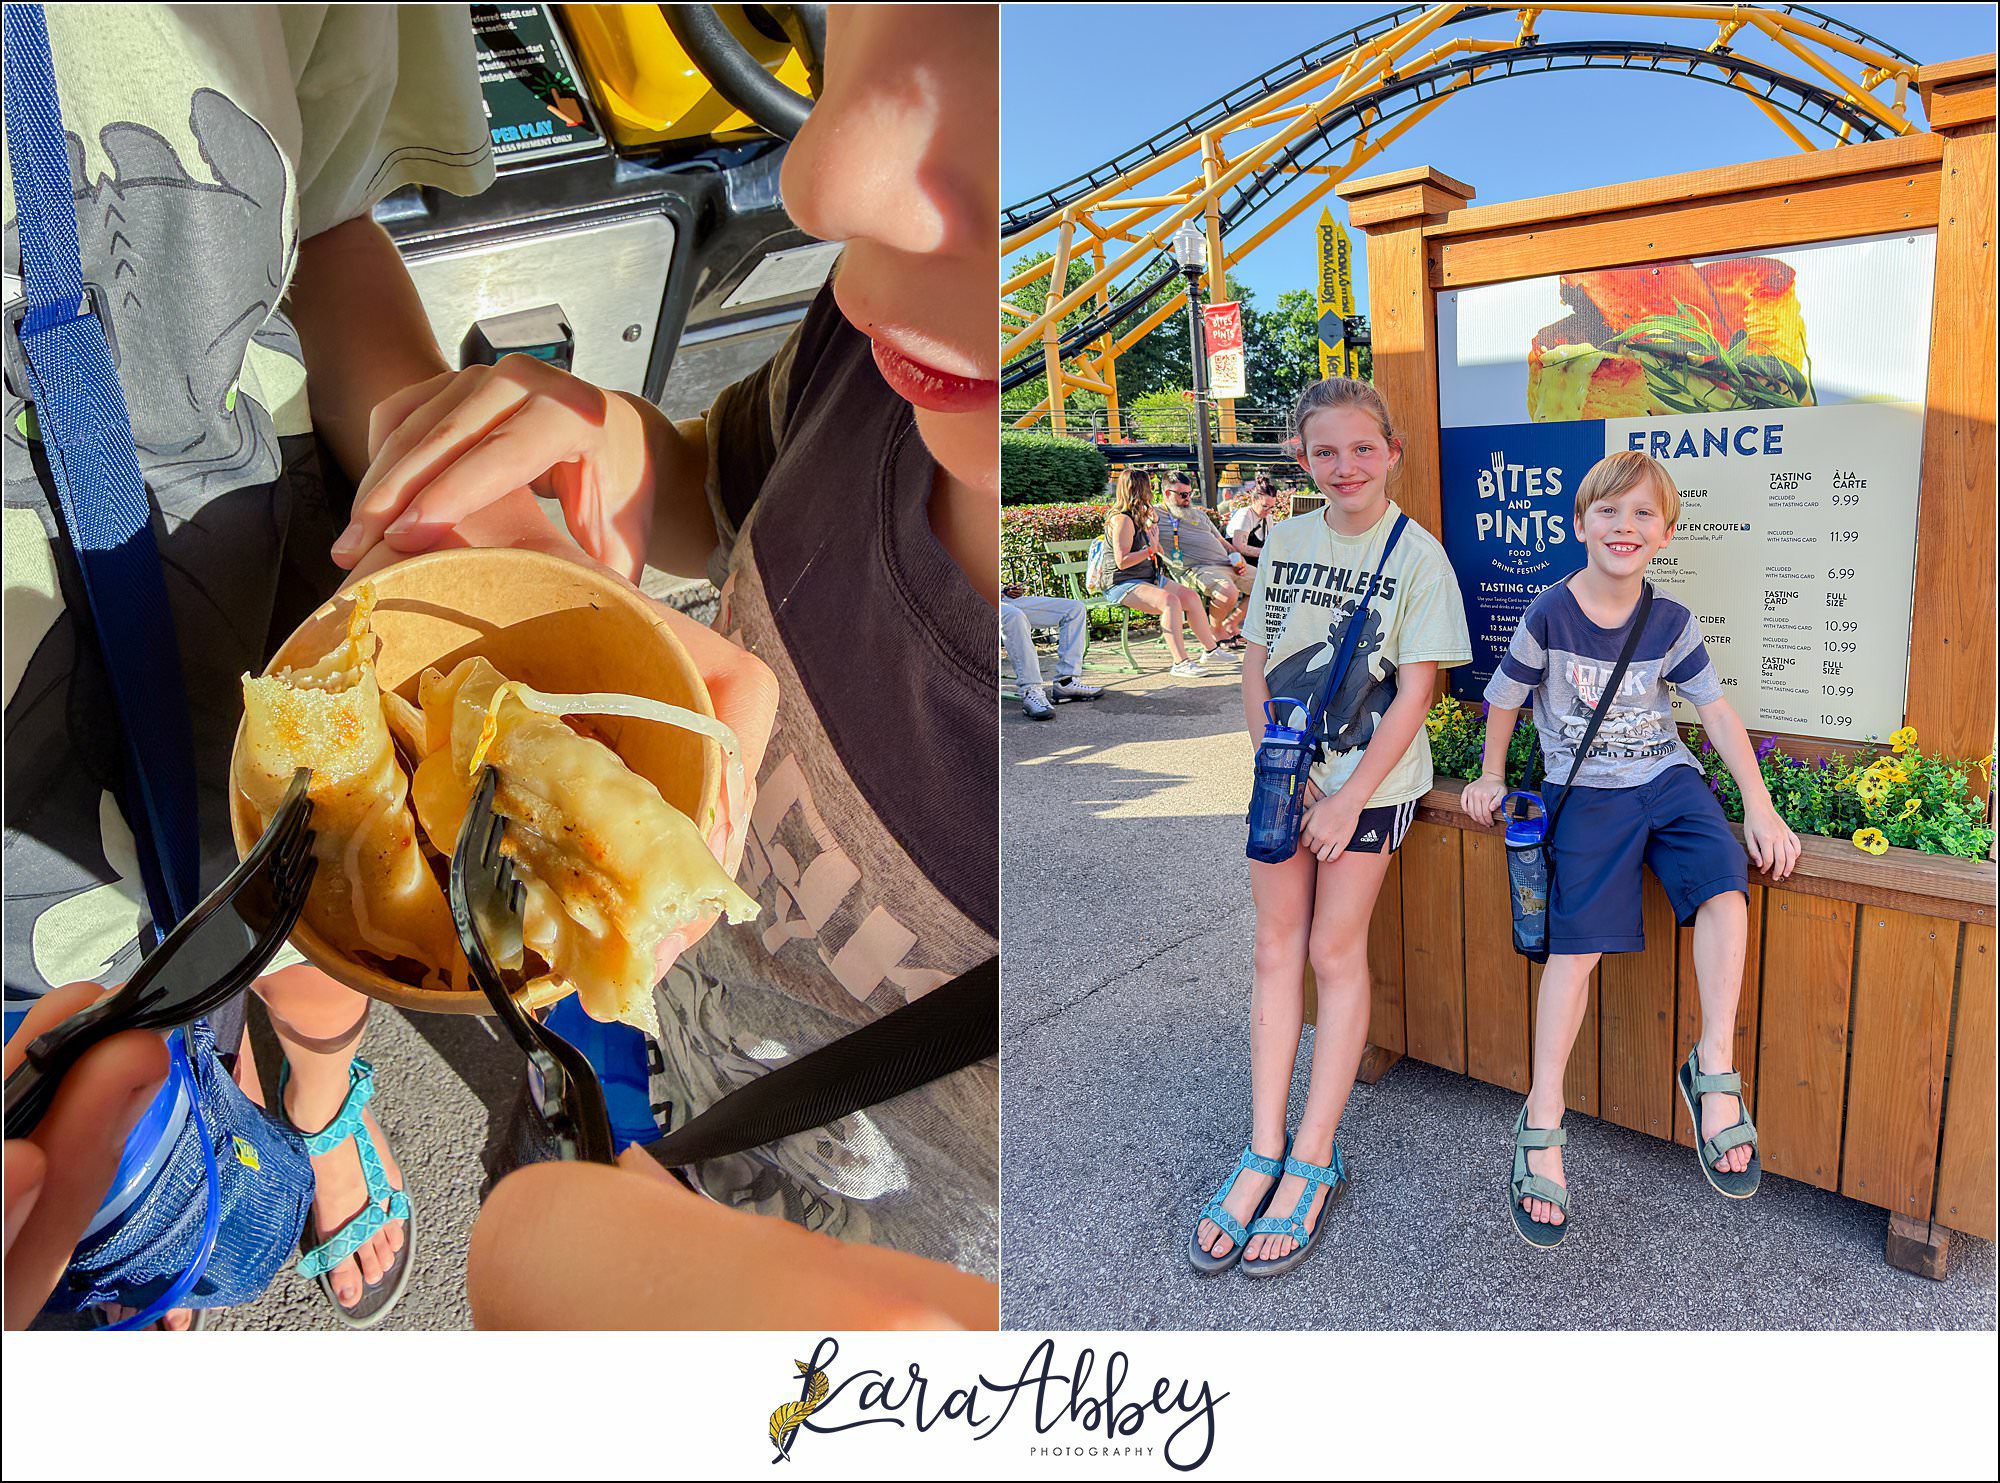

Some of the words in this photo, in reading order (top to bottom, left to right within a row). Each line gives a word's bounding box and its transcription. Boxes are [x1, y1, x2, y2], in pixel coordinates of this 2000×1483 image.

[490, 125, 521, 143] PER
[519, 120, 553, 139] PLAY
[516, 137, 552, 151] PAYMENT
[1320, 225, 1336, 304] Kennywood
[1213, 313, 1233, 328] BITES
[1212, 329, 1235, 342] PINTS
[1628, 425, 1784, 459] FRANCE
[1477, 451, 1563, 501] BITES
[1770, 472, 1812, 481] TASTING
[1770, 481, 1798, 490] CARD
[1833, 480, 1867, 488] CARTE
[1508, 500, 1531, 509] AND
[1832, 495, 1859, 506] 9.99
[1476, 510, 1566, 546] PINTS
[1703, 523, 1738, 531] CROUTE
[1830, 531, 1859, 542] 11.99
[1492, 559, 1515, 574] DRINK
[1516, 561, 1551, 575] FESTIVAL
[1828, 568, 1855, 579] 6.99
[1272, 561, 1397, 600] TOOTHLESS
[1480, 583, 1523, 593] TASTING
[1265, 587, 1299, 603] NIGHT
[1301, 589, 1343, 608] FURY
[1498, 615, 1520, 623] SAMPL
[1700, 616, 1726, 624] CIDER
[1825, 621, 1857, 632] 10.99
[1481, 635, 1511, 643] PASSHOL
[1824, 641, 1856, 652] 10.99
[1762, 657, 1796, 665] TASTING
[1762, 663, 1785, 671] CARD
[1822, 685, 1854, 696] 10.99
[1820, 715, 1852, 726] 10.99
